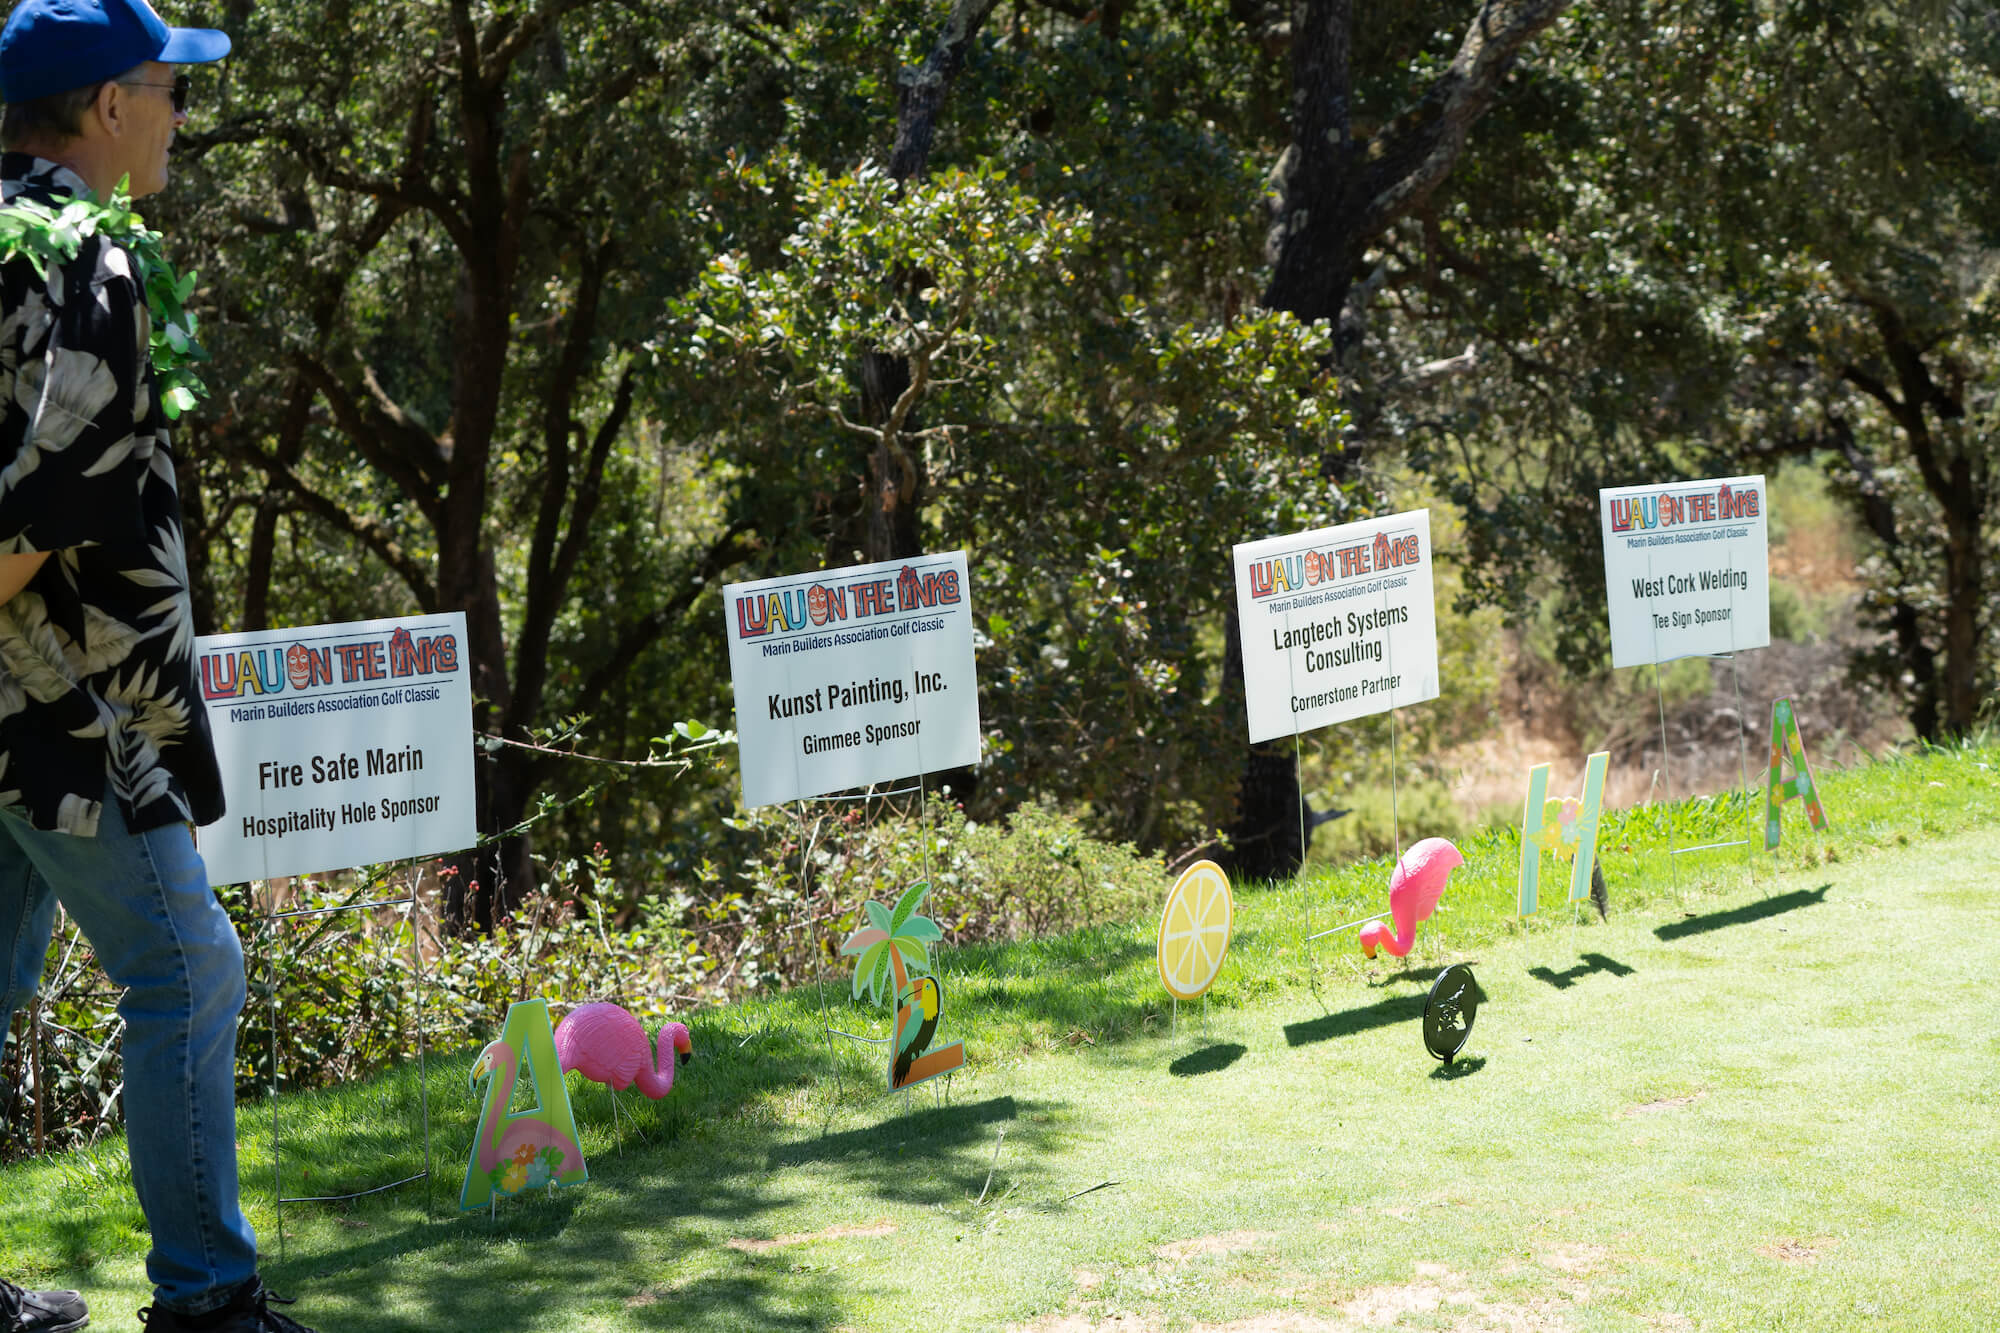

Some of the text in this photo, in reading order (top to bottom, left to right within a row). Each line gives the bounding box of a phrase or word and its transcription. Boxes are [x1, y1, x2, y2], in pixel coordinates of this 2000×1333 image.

[1610, 484, 1760, 532] LUAU ON THE LINKS
[1628, 528, 1748, 548] Marin Builders Association Golf Classic
[1249, 532, 1420, 599] LUAU ON THE LINKS
[1632, 568, 1747, 599] West Cork Welding
[736, 565, 961, 639] LUAU ON THE LINKS
[1269, 577, 1408, 614] Marin Builders Association Golf Classic
[763, 618, 944, 657] Marin Builders Association Golf Classic
[1274, 606, 1408, 650] Langtech Systems
[1653, 608, 1731, 629] Tee Sign Sponsor
[200, 627, 458, 700] LUAU ON THE LINKS
[1306, 641, 1382, 673] Consulting
[231, 686, 440, 722] Marin Builders Association Golf Classic
[768, 671, 947, 720] Kunst Painting, Inc.
[1291, 674, 1401, 712] Cornerstone Partner
[803, 719, 921, 754] Gimmee Sponsor
[259, 745, 423, 790] Fire Safe Marin
[242, 794, 440, 838] Hospitality Hole Sponsor
